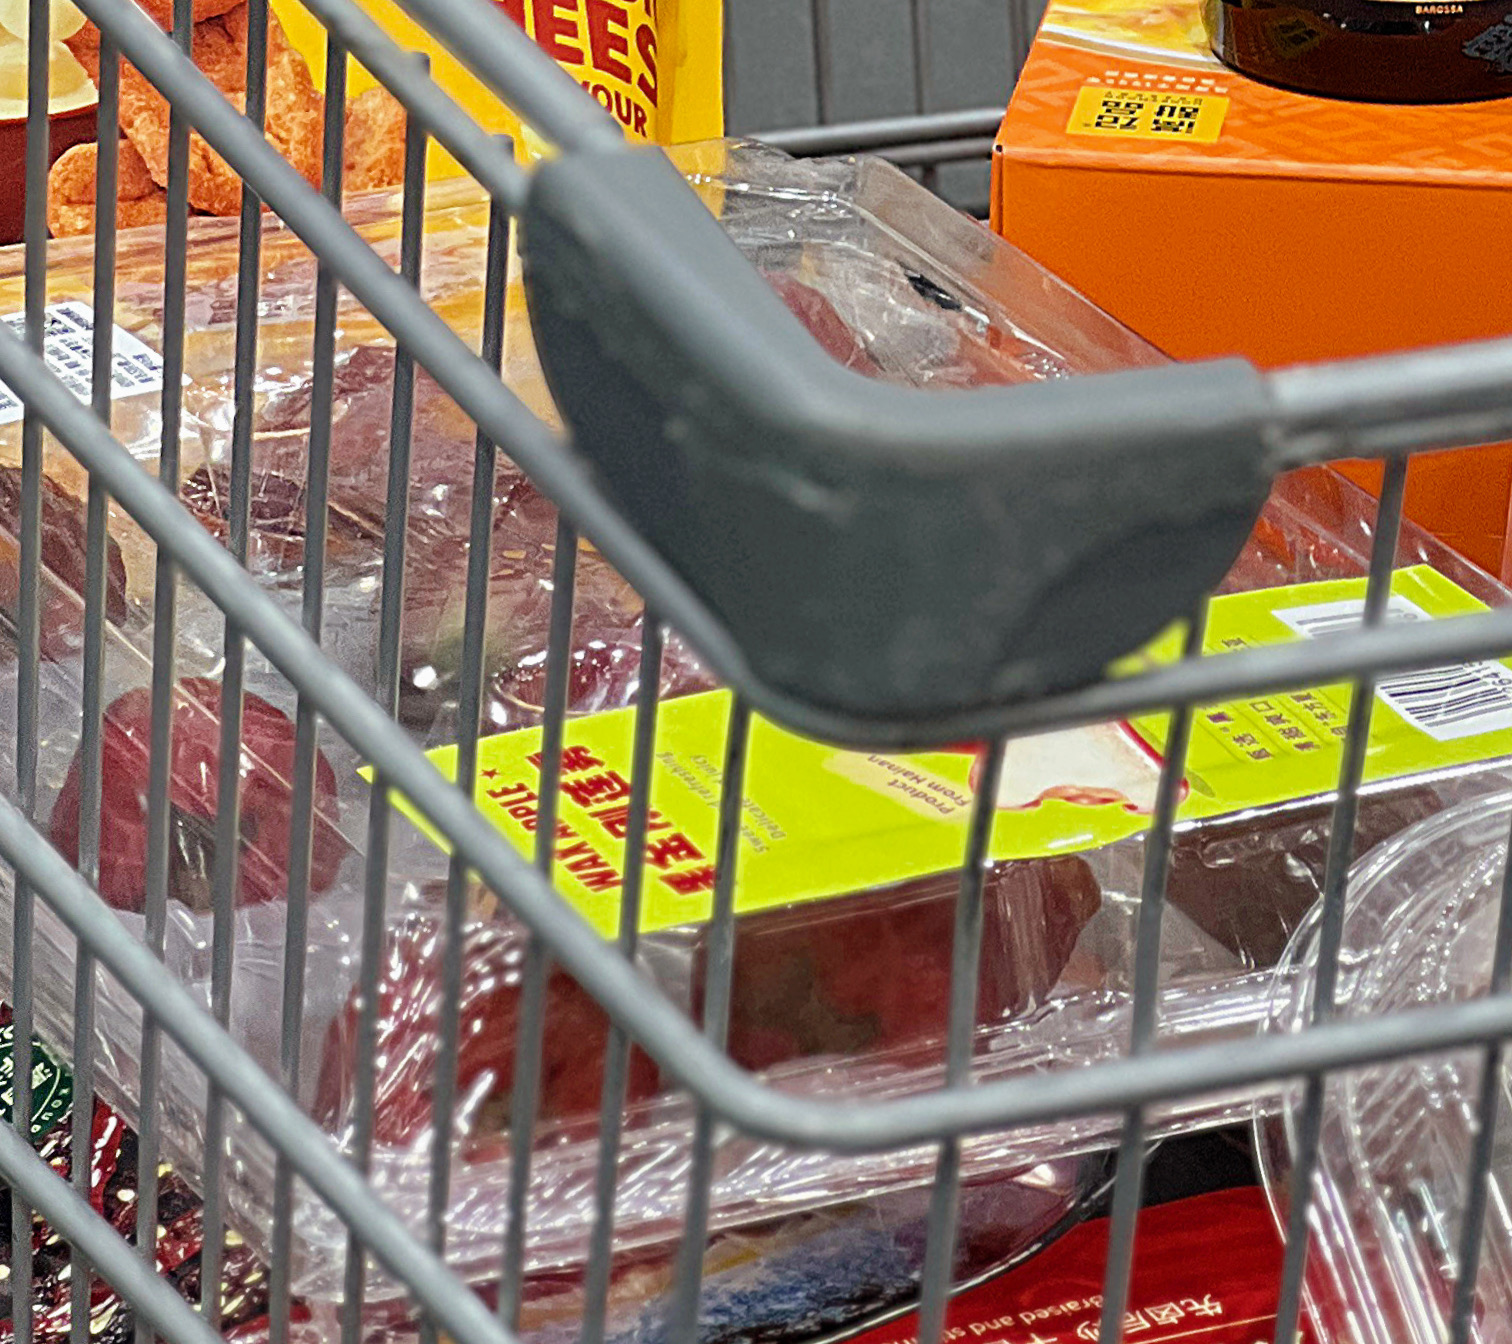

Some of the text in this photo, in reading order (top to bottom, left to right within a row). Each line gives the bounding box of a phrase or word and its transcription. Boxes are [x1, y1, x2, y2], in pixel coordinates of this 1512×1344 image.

[867, 753, 972, 807] From Hainan
[887, 778, 957, 814] Product
[968, 1317, 1016, 1338] and
